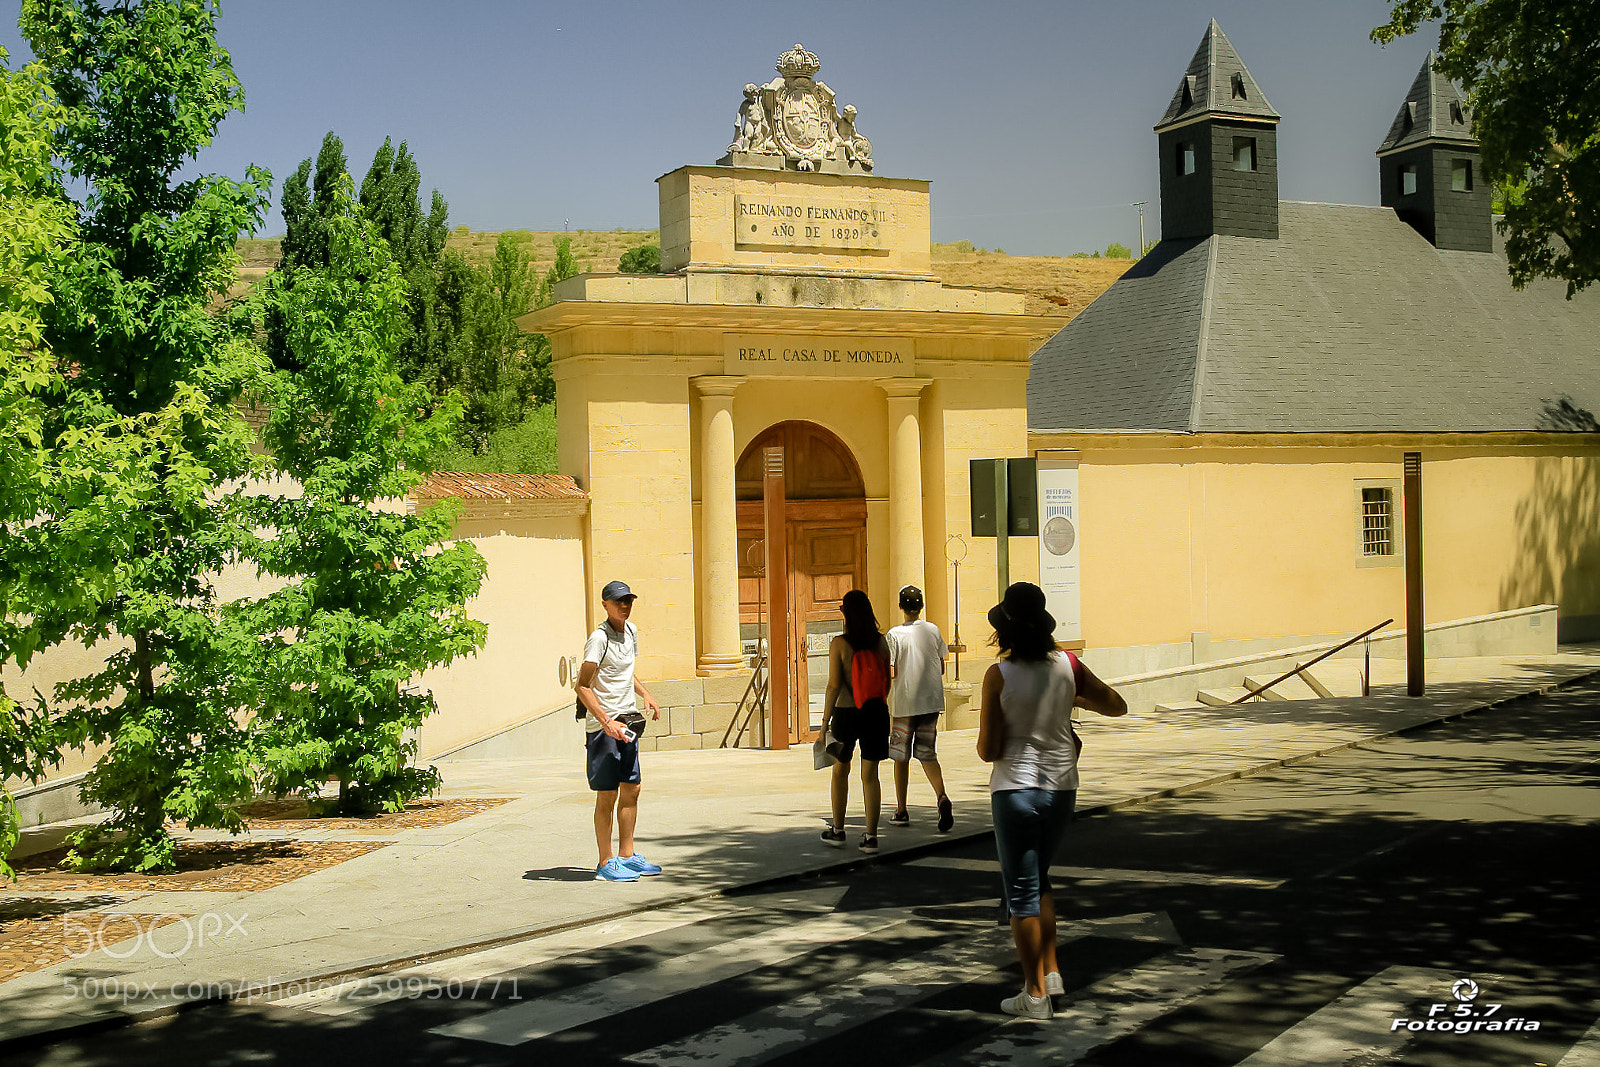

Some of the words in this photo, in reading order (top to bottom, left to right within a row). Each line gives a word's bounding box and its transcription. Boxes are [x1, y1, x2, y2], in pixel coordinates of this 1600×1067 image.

[740, 203, 803, 218] REINANDO
[807, 206, 868, 222] FERNANDO
[771, 222, 795, 237] AÑO
[805, 226, 821, 238] DE
[738, 348, 777, 362] REAL
[783, 349, 817, 362] CASA
[824, 350, 841, 363] DE
